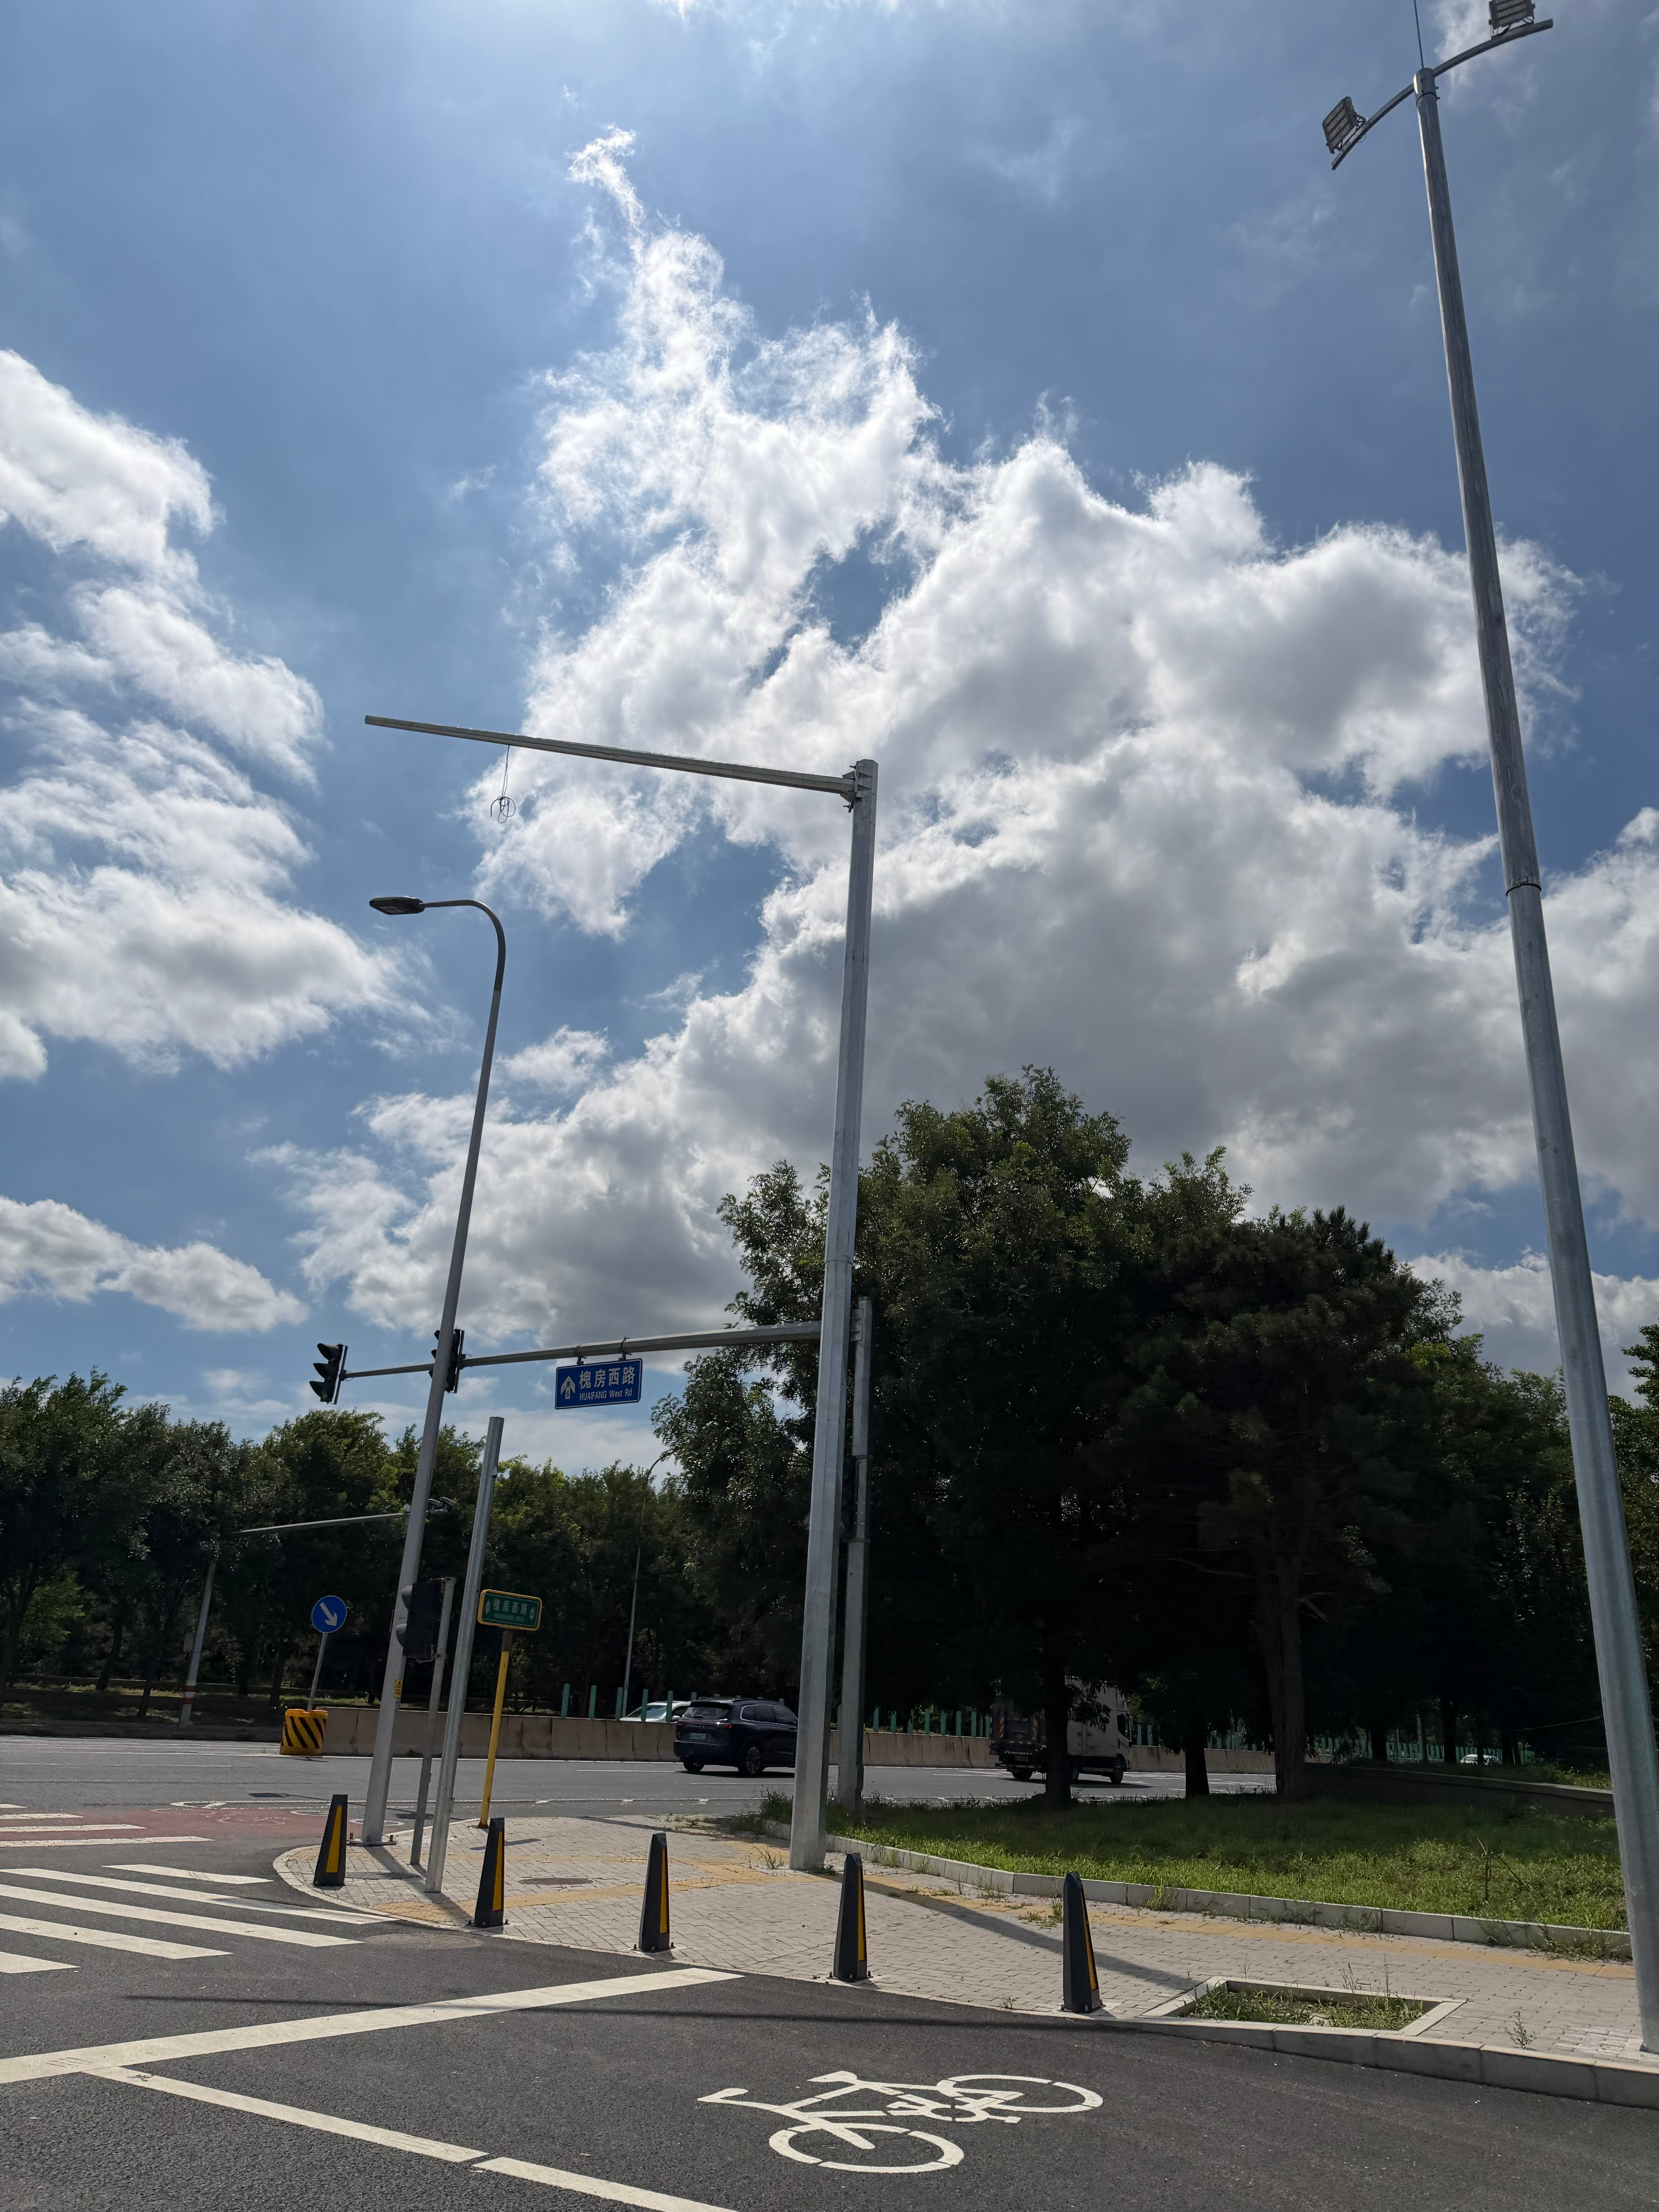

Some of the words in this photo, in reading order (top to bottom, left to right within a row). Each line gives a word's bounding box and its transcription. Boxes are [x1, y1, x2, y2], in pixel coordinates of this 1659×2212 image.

[579, 1366, 635, 1389] 槐房西路
[579, 1390, 607, 1400] HUAIFANG
[610, 1389, 622, 1398] West
[625, 1388, 632, 1397] Rd
